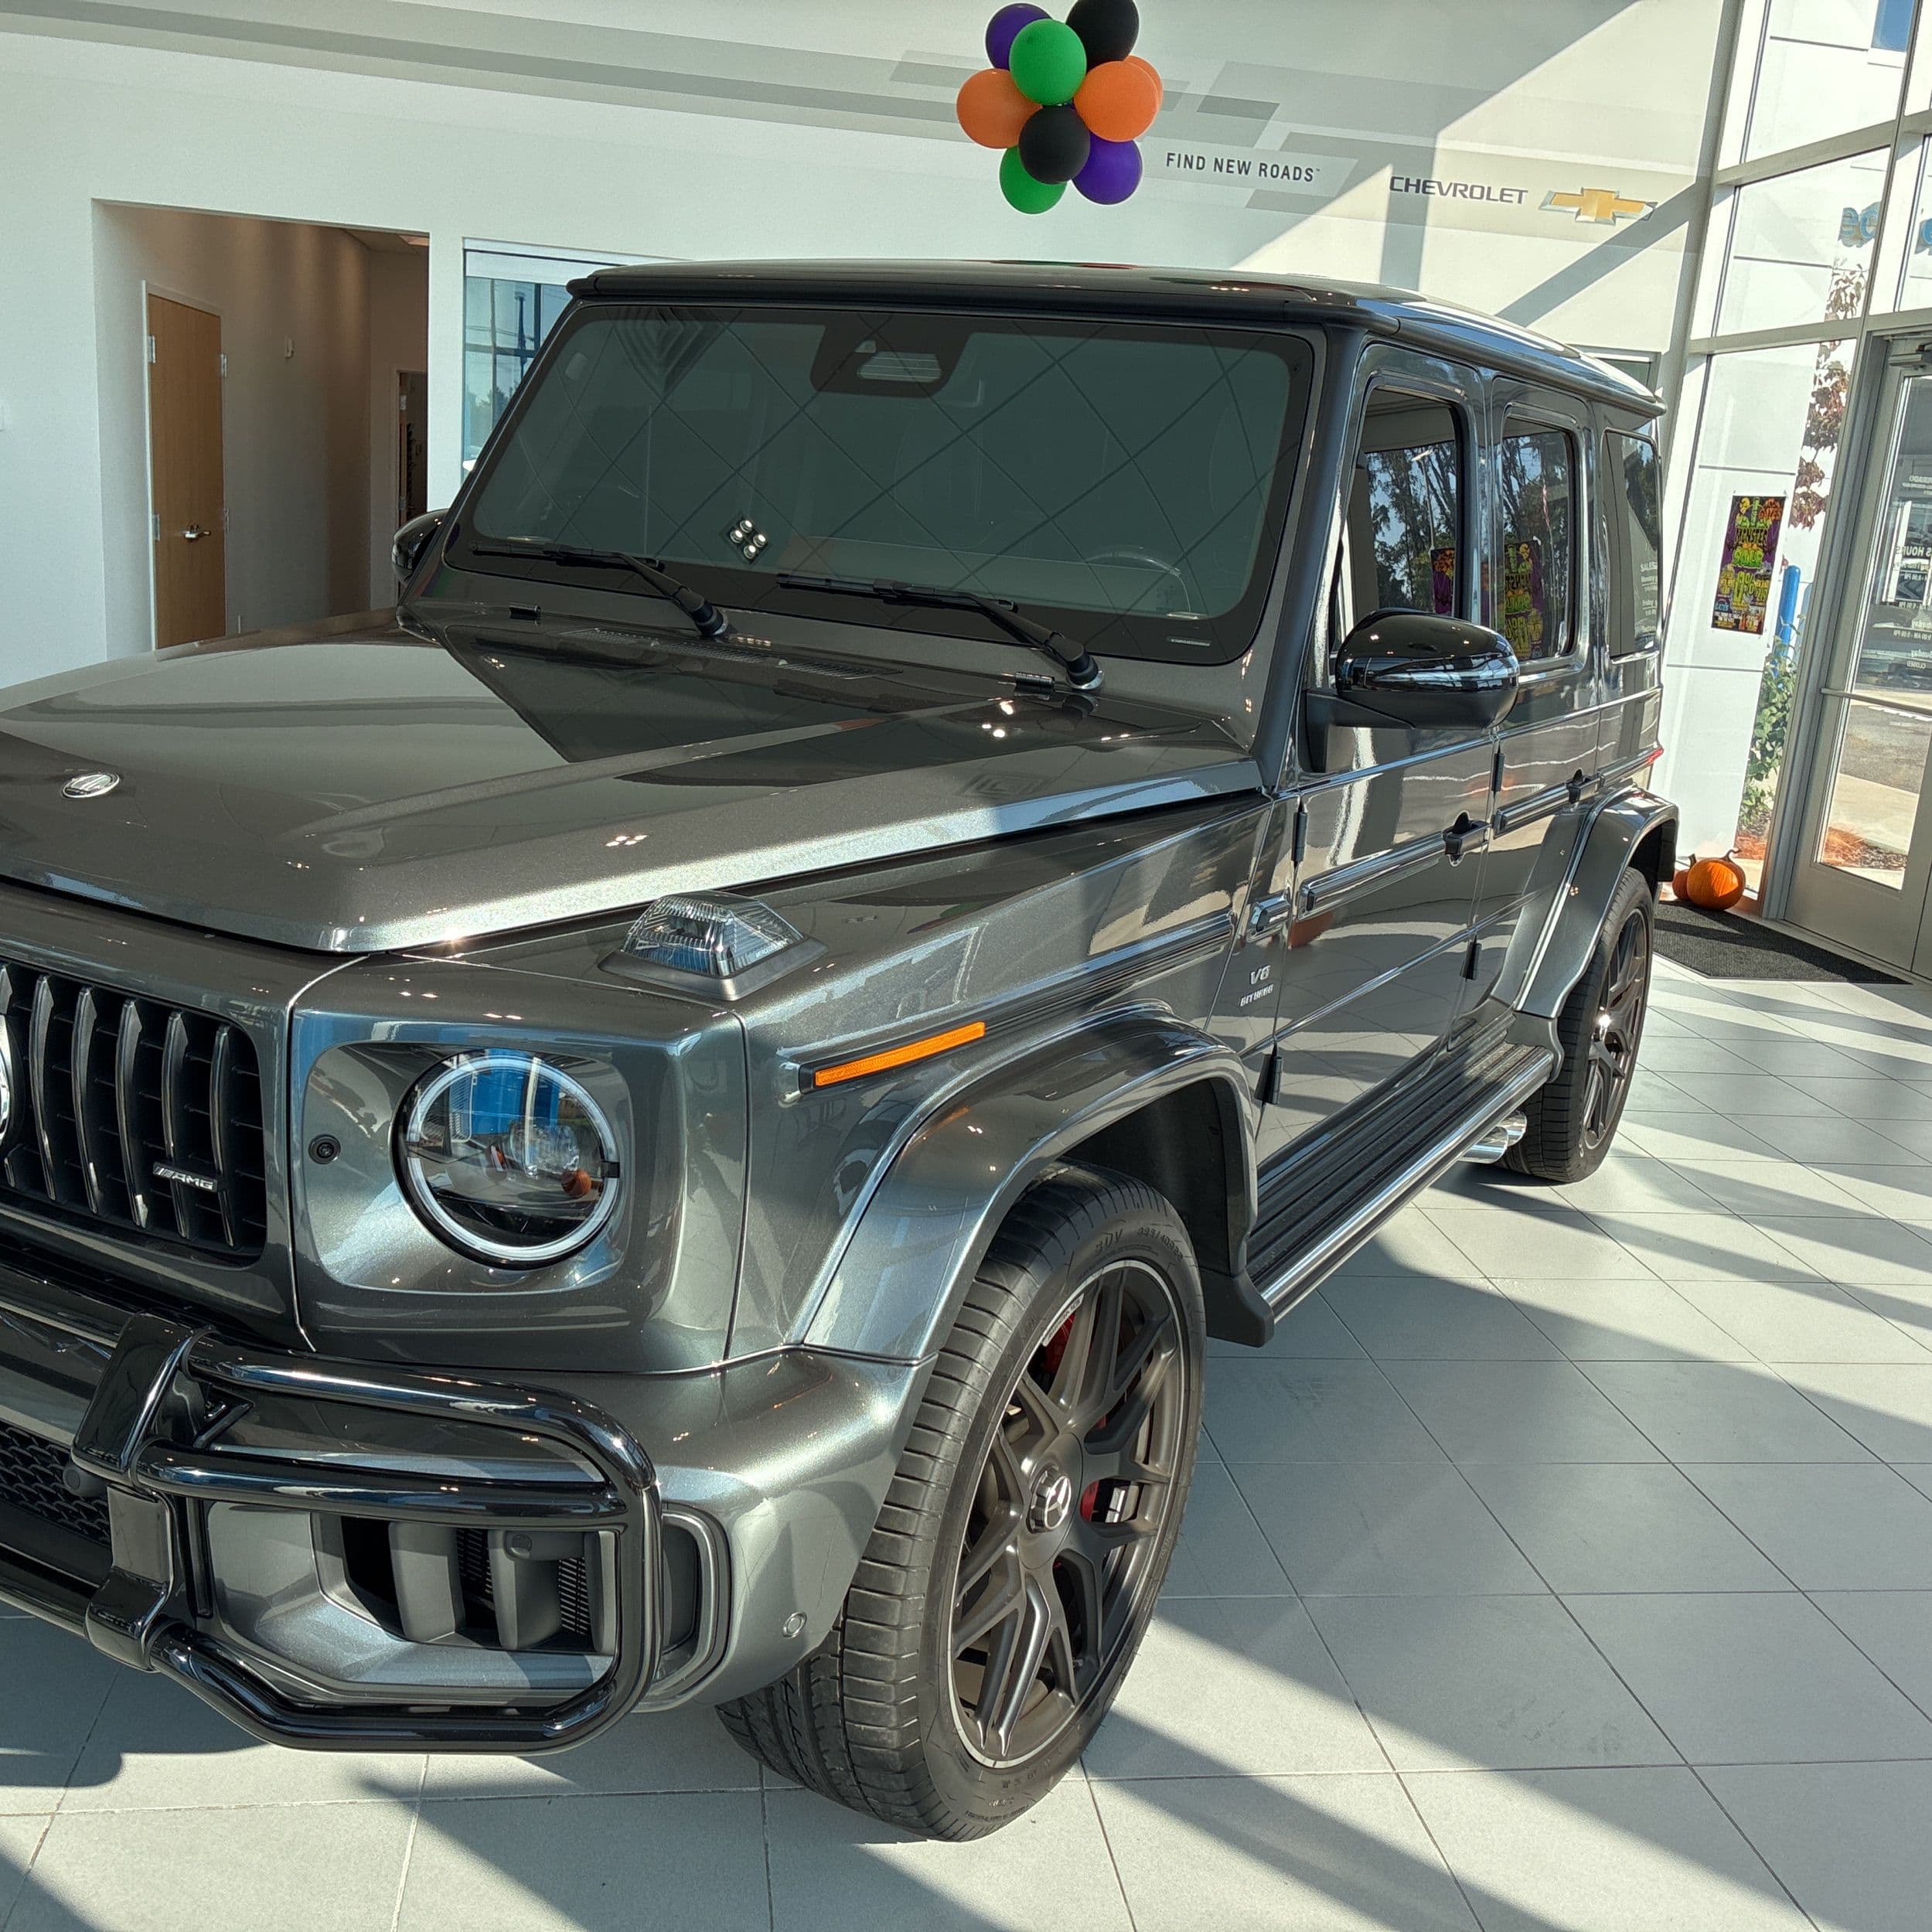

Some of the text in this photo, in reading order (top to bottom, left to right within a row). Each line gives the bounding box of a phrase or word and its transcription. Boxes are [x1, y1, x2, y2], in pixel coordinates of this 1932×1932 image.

[1166, 152, 1314, 182] FIND NEW ROADS
[1389, 175, 1528, 204] CHEVROLET
[171, 1170, 214, 1191] AMG
